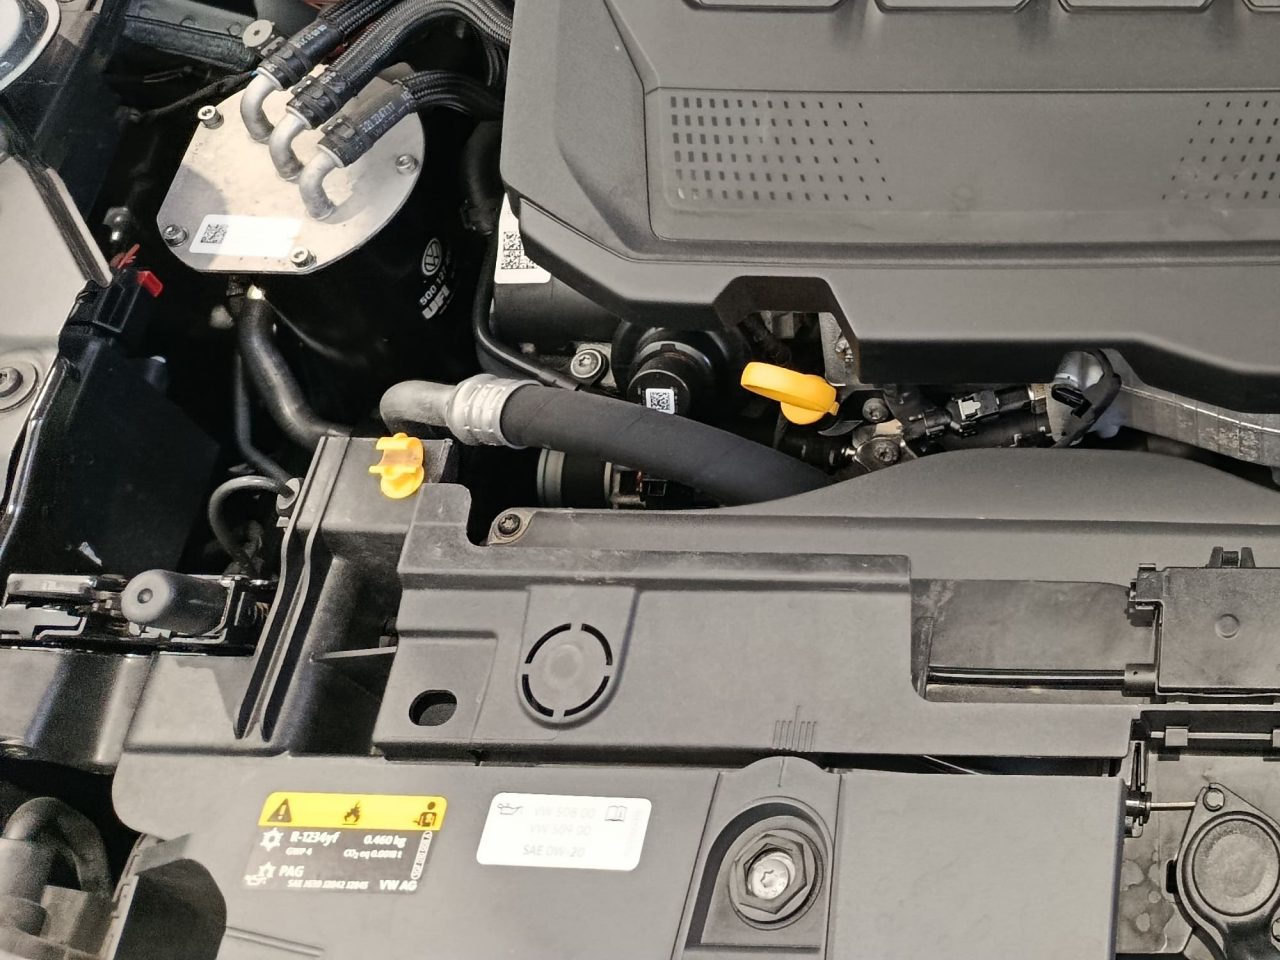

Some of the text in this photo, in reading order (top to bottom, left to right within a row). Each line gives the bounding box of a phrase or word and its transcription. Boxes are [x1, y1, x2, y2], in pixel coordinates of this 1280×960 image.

[421, 284, 450, 320] UFI
[289, 831, 341, 847] R-1234yf
[393, 835, 407, 848] kg
[522, 844, 544, 856] SAE
[278, 865, 304, 877] PAG
[379, 879, 418, 891] VW AG
